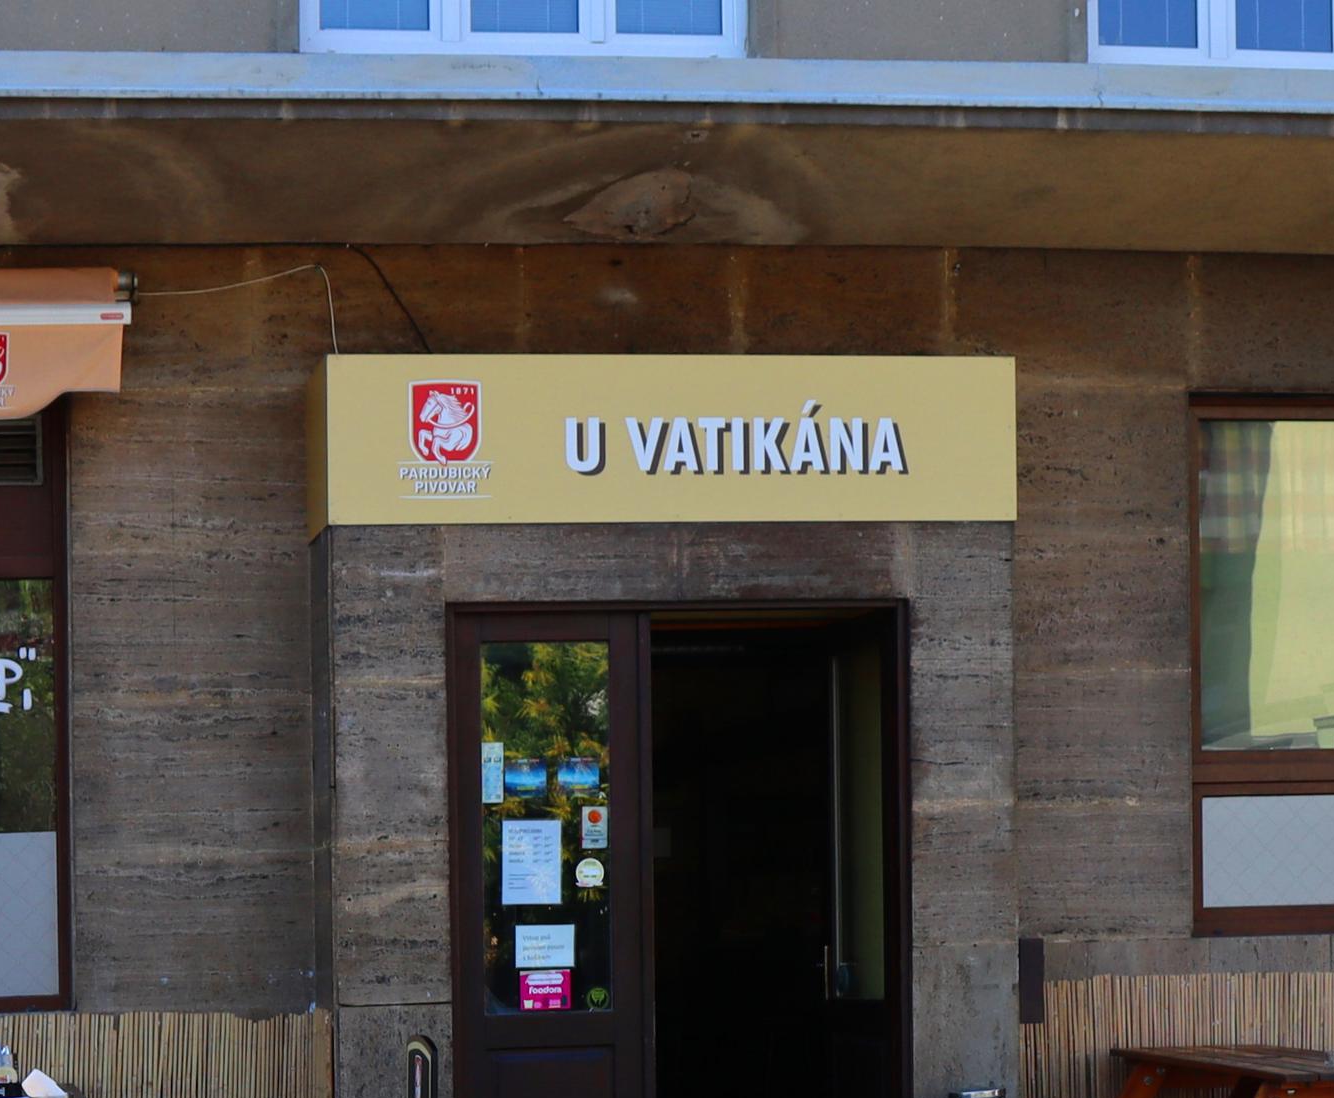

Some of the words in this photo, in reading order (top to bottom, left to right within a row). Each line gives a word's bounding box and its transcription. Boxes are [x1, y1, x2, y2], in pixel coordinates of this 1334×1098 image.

[450, 387, 475, 395] 1871
[564, 416, 606, 476] U
[624, 399, 909, 475] VATIKÁNA
[399, 464, 492, 480] PARDUBICKÝ
[414, 481, 478, 494] PIVOVAR
